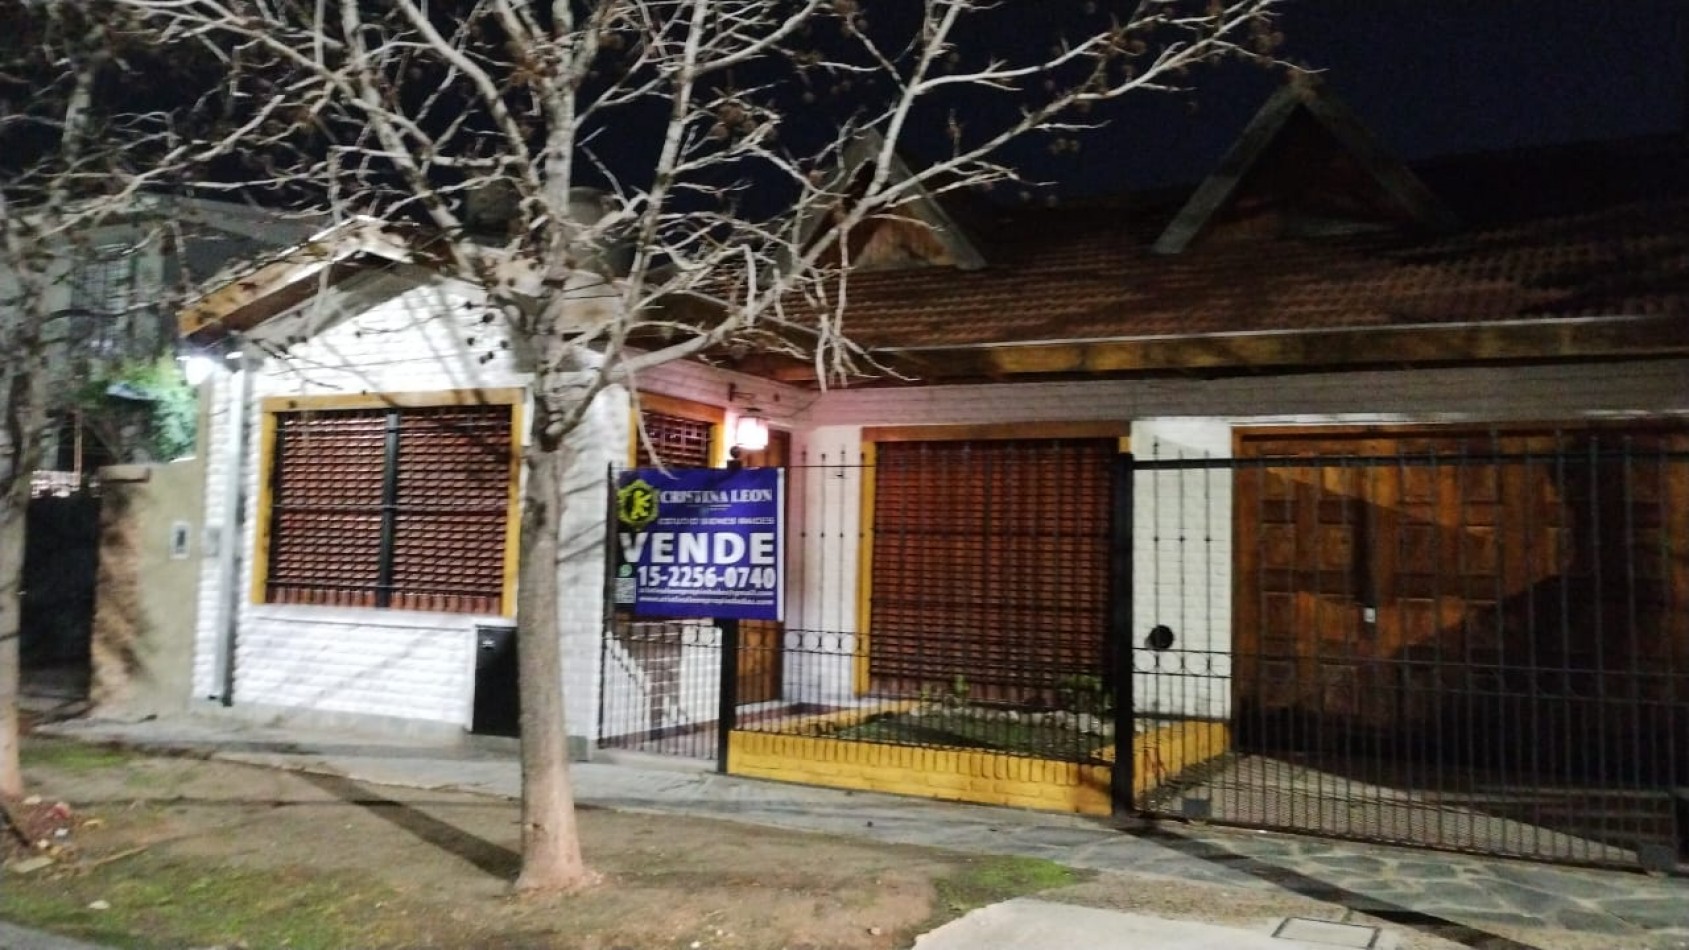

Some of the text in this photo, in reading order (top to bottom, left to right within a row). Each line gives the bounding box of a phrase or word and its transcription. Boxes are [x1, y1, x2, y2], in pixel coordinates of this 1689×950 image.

[660, 489, 772, 504] CRISTINA LEON
[619, 532, 775, 565] VENDE
[638, 565, 776, 589] 15-2256-0740
